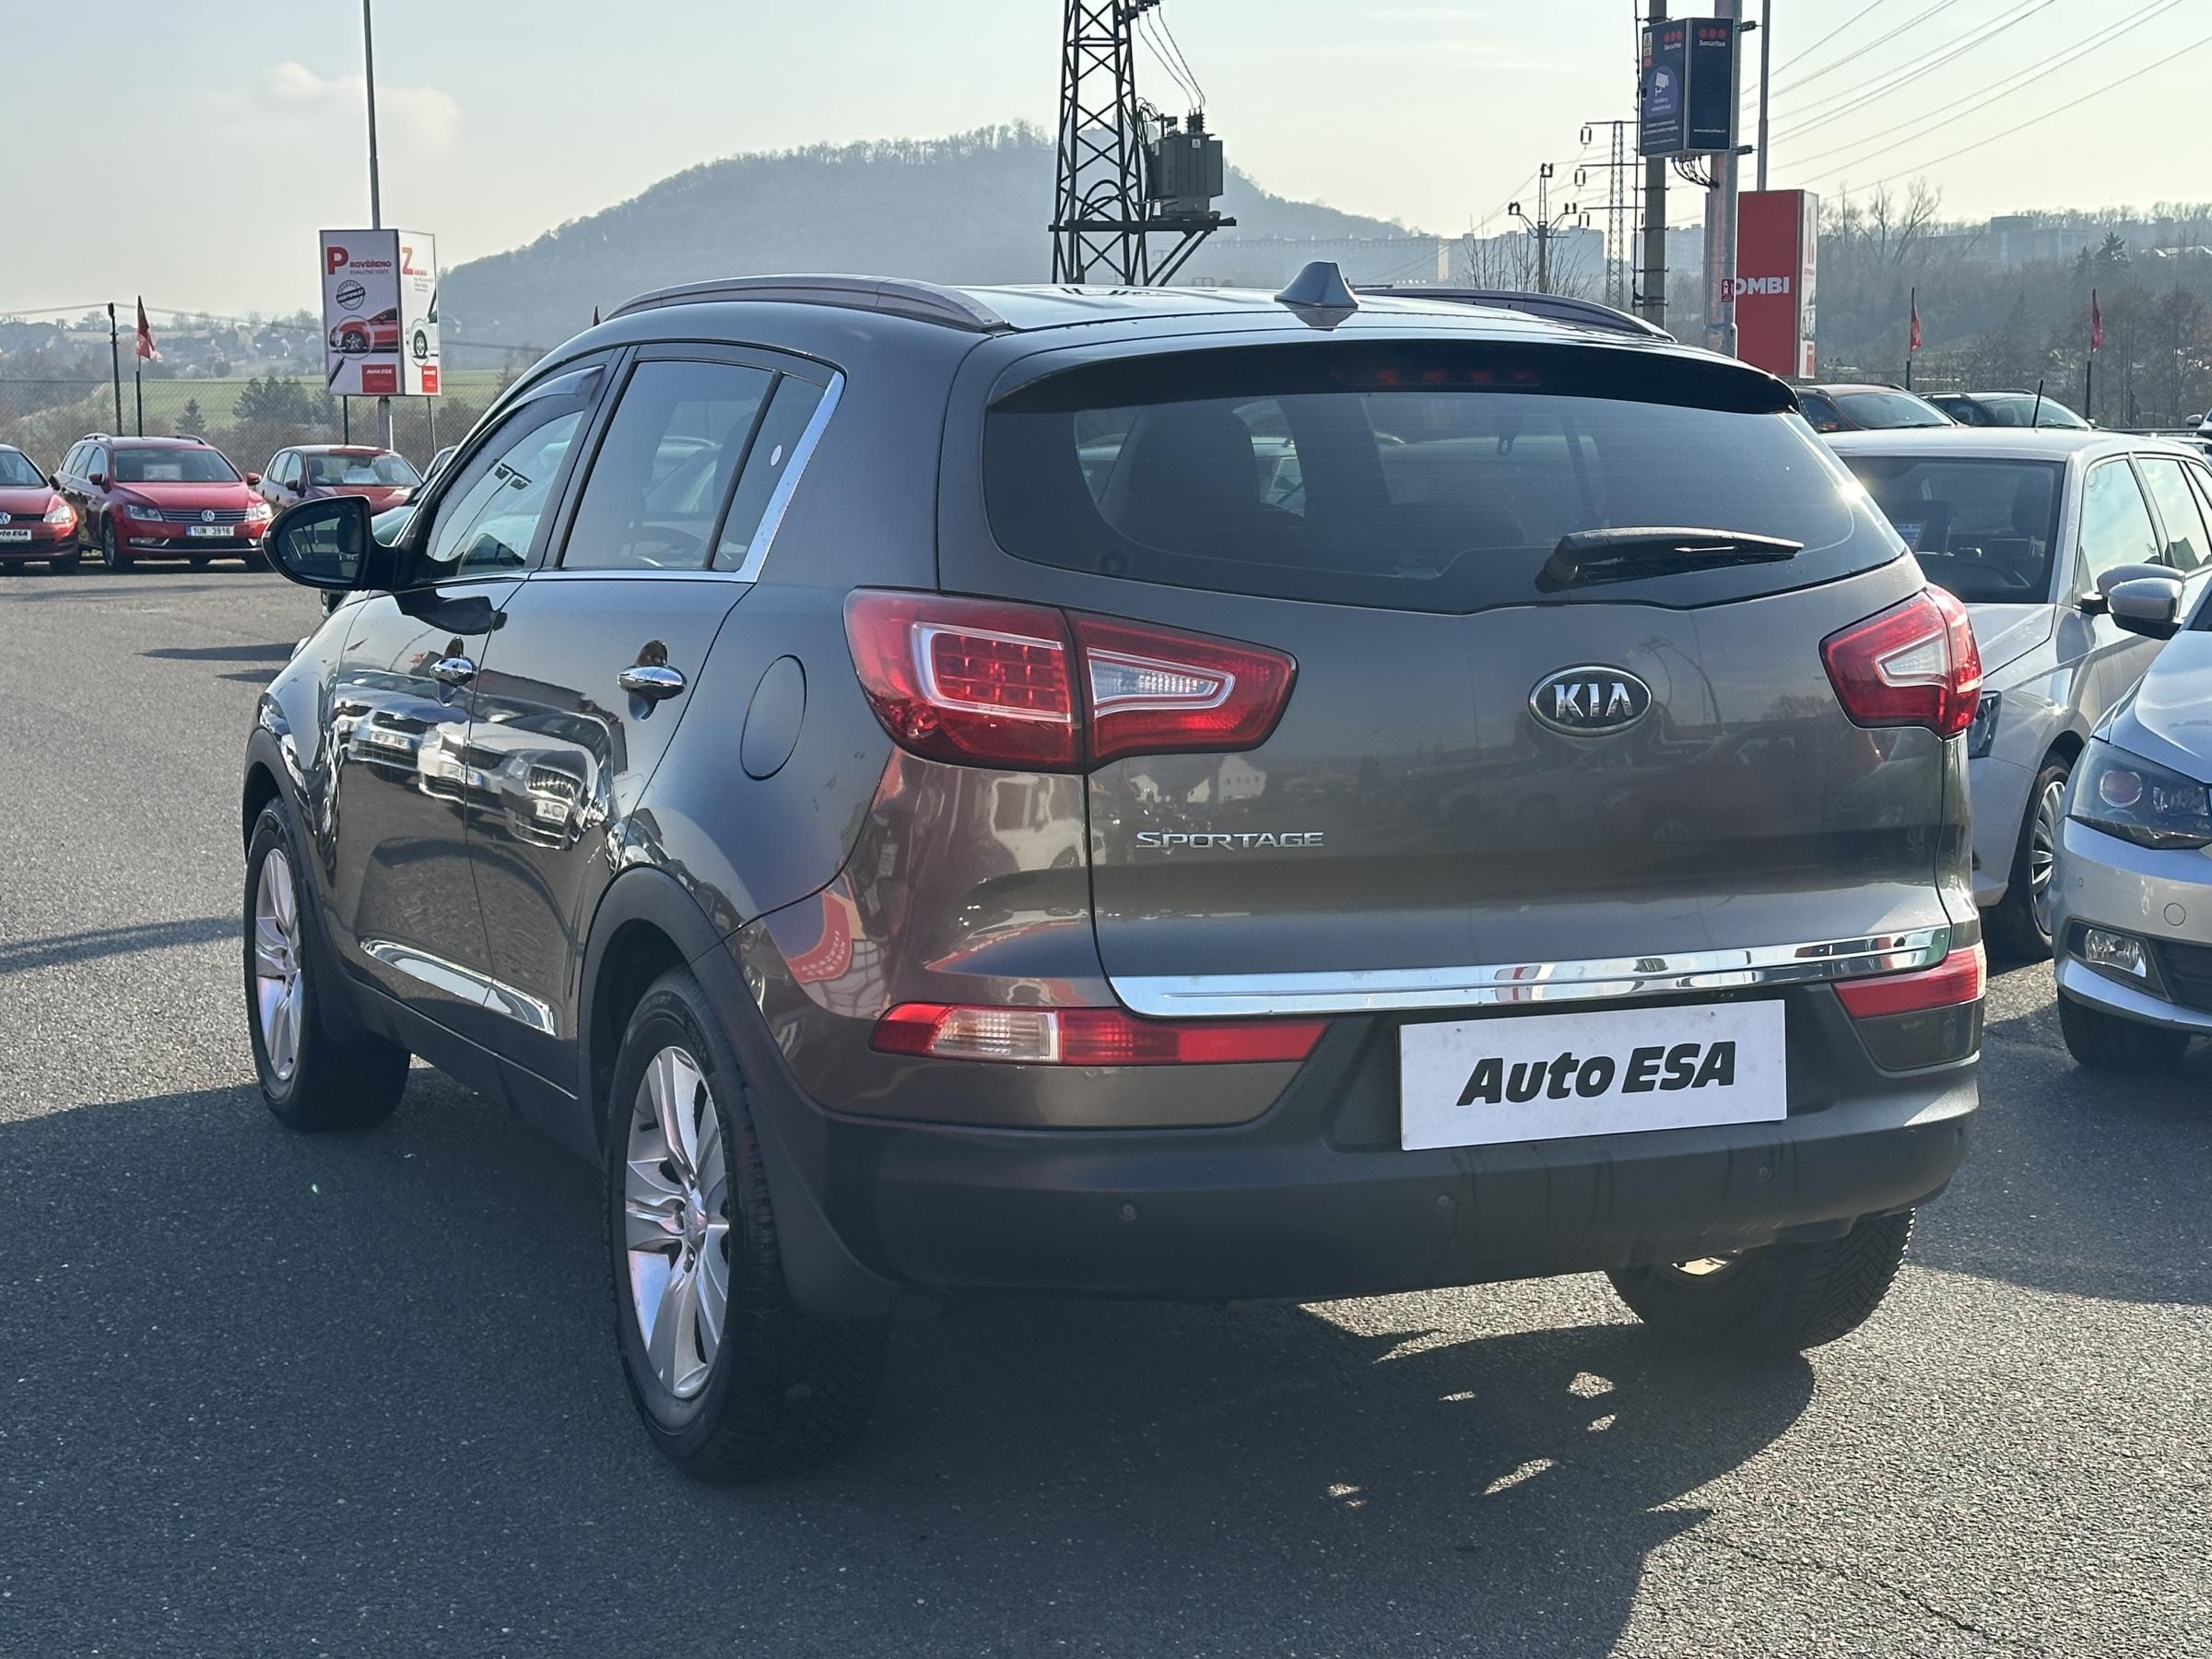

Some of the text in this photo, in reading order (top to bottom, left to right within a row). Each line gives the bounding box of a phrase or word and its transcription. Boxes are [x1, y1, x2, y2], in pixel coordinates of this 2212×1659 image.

[1735, 276, 1790, 295] OMBI
[1553, 682, 1634, 719] KIA
[1135, 831, 1324, 851] SPORTAGE
[1455, 1041, 1736, 1107] Auto ESA
